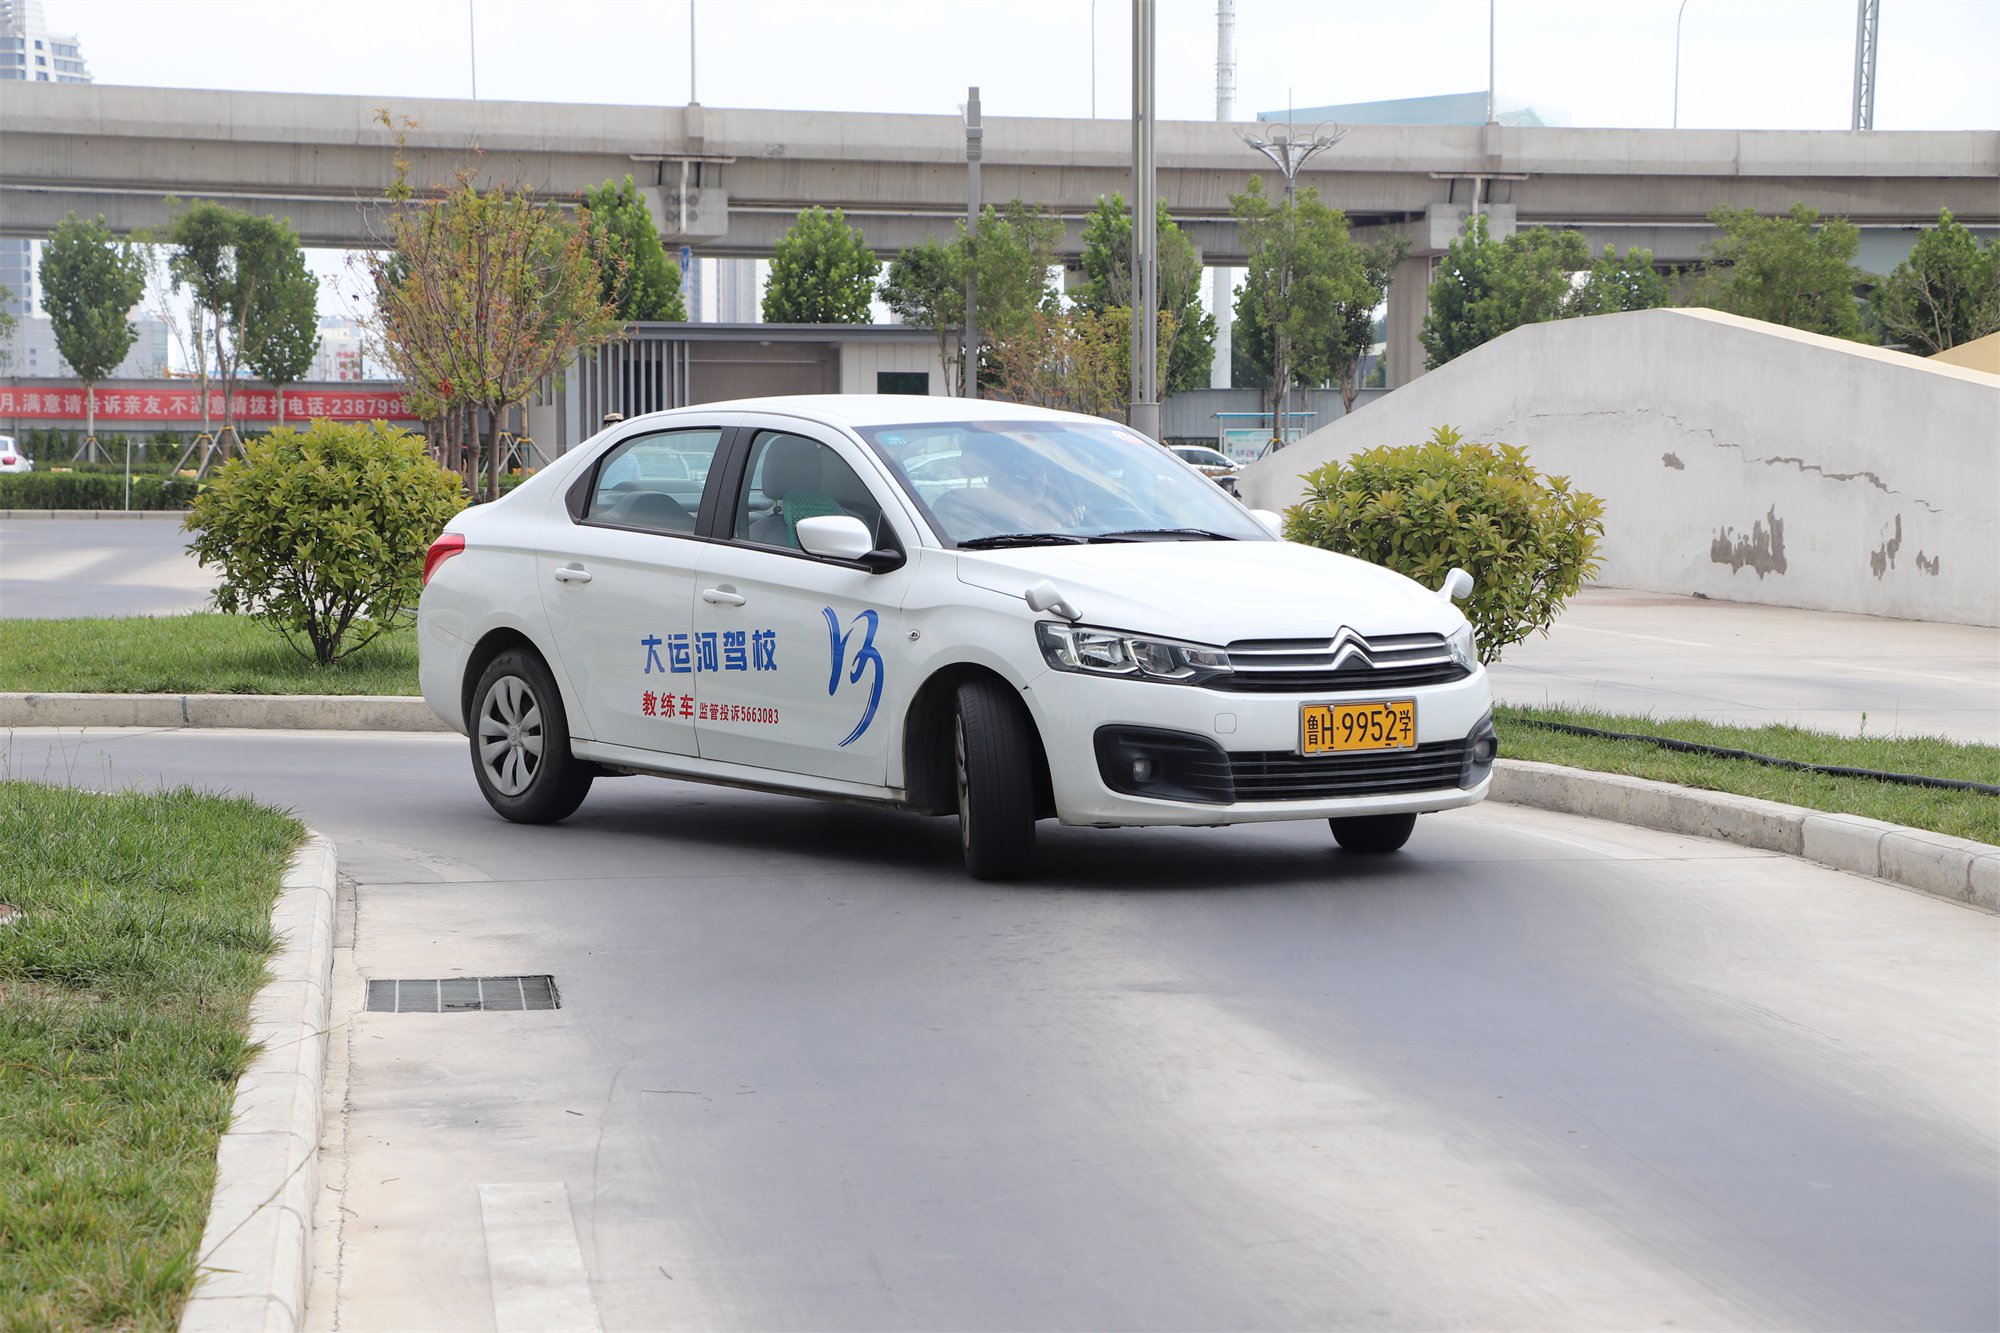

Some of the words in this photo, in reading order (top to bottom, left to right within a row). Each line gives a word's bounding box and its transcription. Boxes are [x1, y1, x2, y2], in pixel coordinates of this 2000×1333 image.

[641, 629, 777, 674] 大运河驾校
[642, 690, 694, 719] 教练车
[699, 702, 779, 724] 监管投诉5663083
[1307, 709, 1412, 746] 鲁H·9952学
